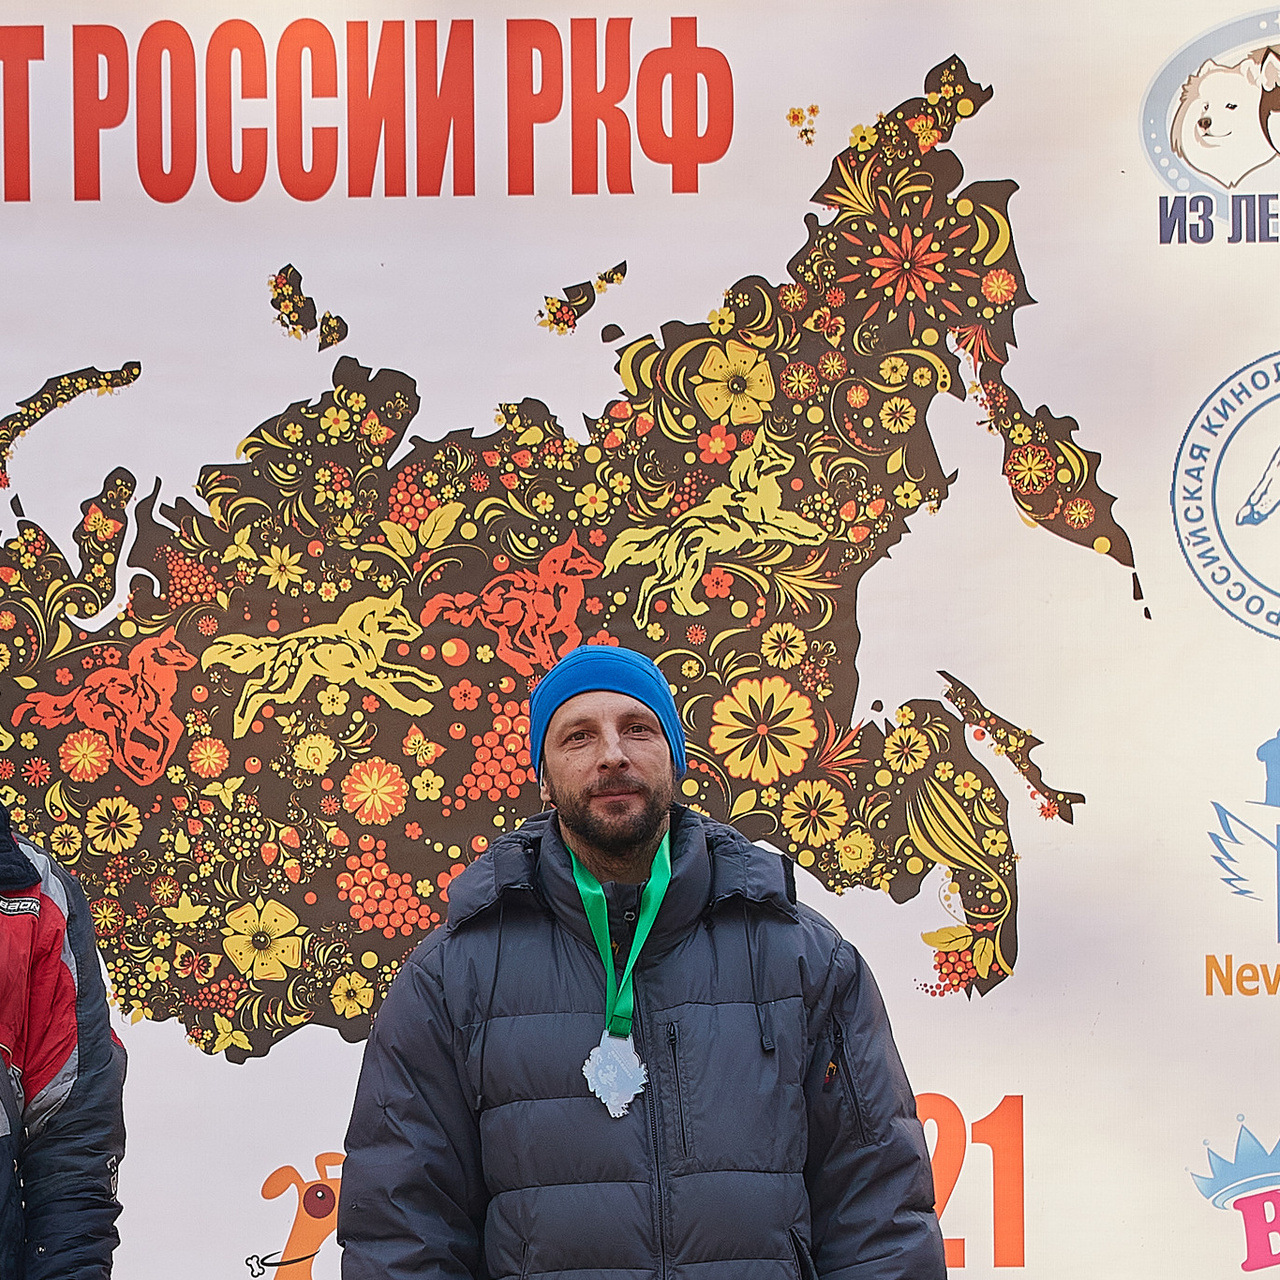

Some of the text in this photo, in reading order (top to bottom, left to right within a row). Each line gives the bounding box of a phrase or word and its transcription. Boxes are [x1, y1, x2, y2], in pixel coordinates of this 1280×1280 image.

[72, 17, 476, 203] РОССИИ
[507, 16, 735, 197] РКФ
[1158, 195, 1214, 245] ИЗ
[1183, 443, 1280, 626] РОССИЙСКАЯ
